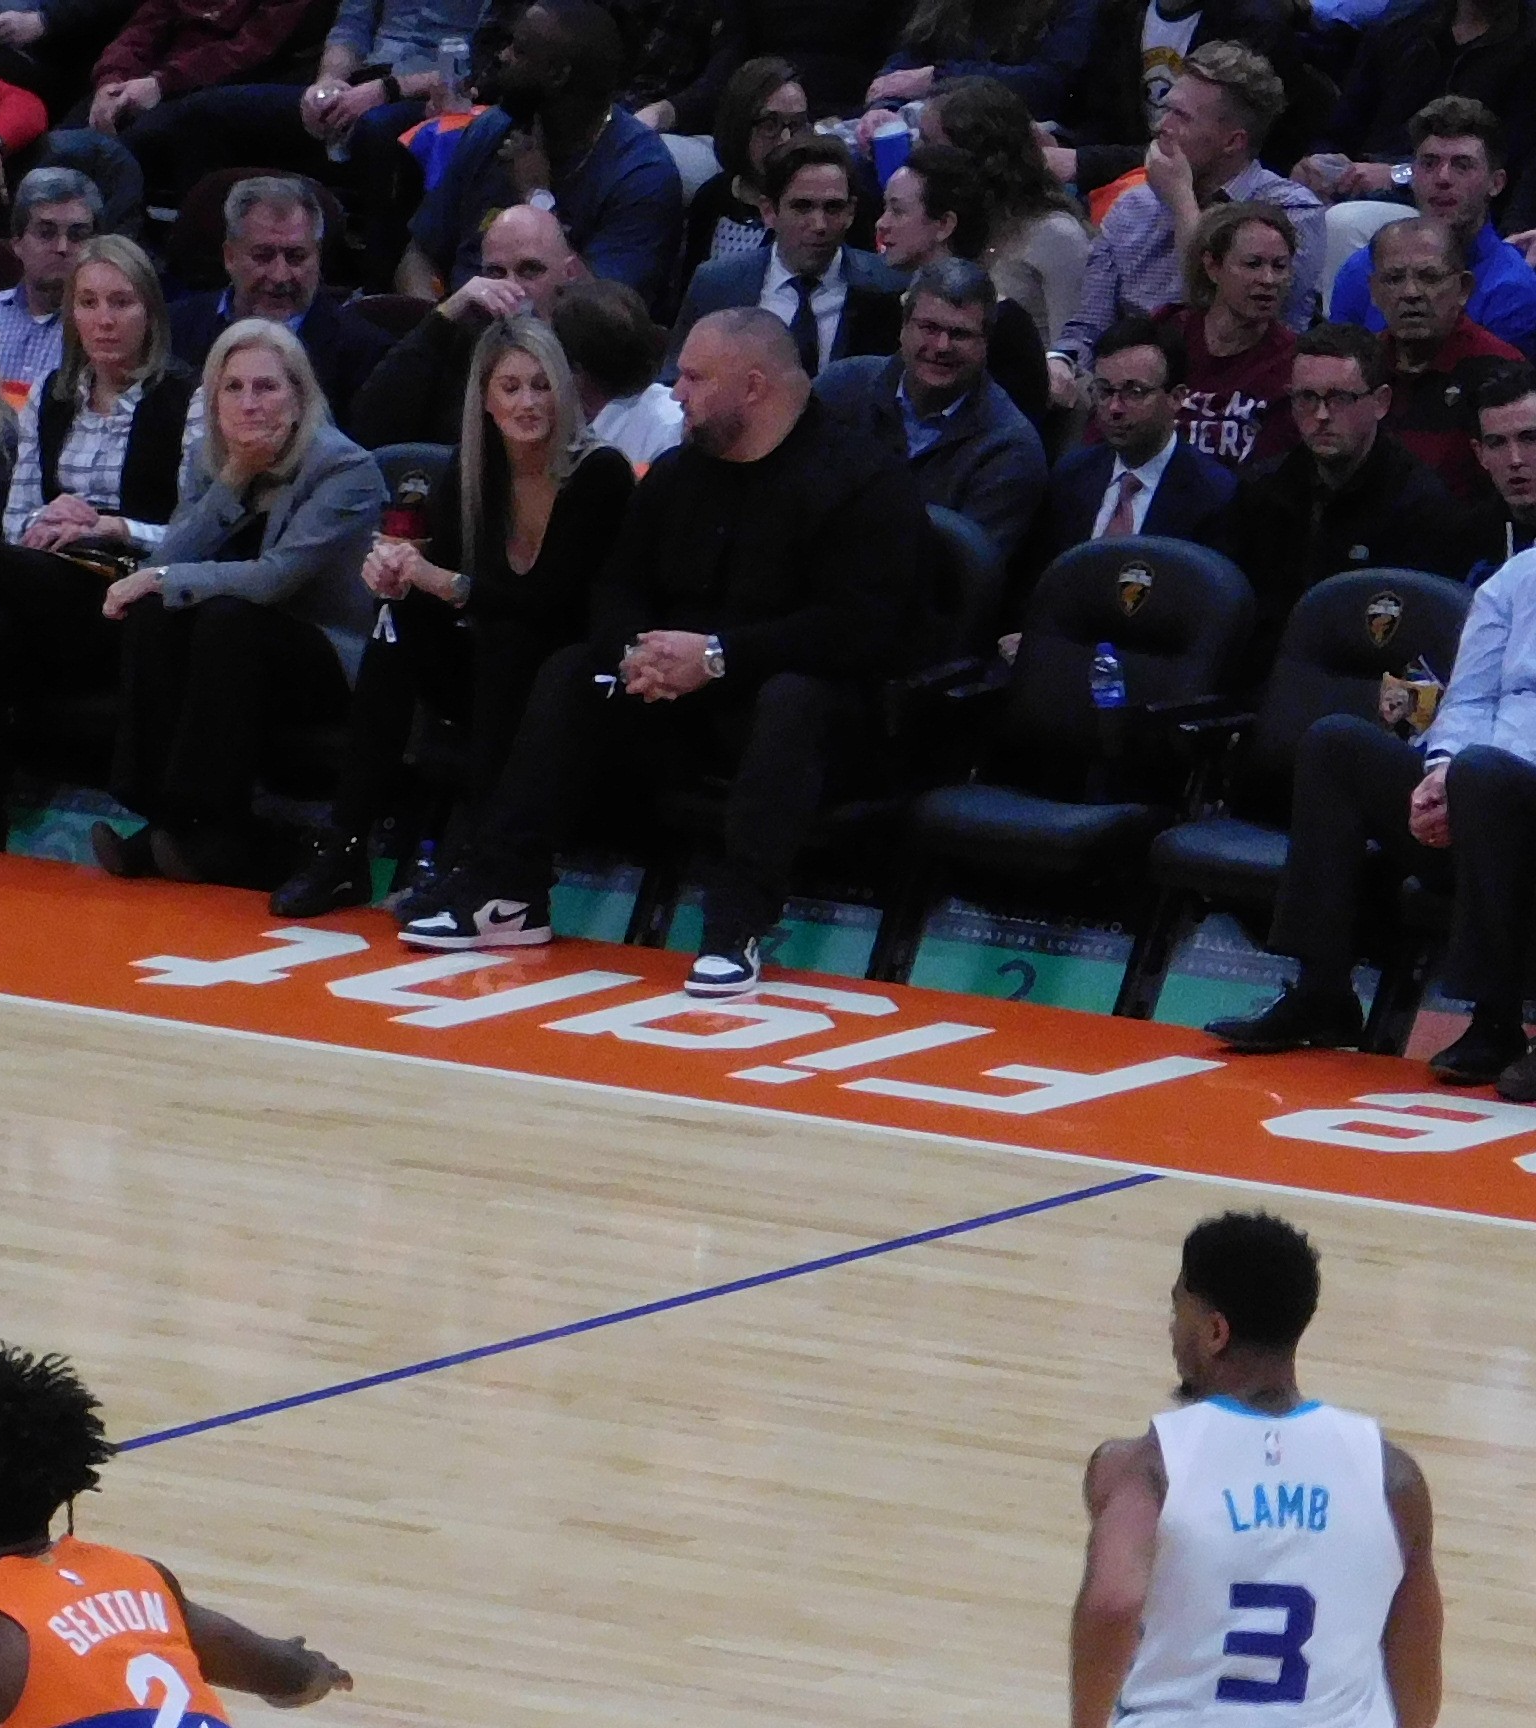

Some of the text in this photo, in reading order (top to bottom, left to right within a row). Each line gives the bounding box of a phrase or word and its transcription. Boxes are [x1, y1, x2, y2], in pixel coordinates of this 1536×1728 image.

[128, 925, 1228, 1114] Fight
[1221, 1480, 1330, 1532] LAMB
[47, 1589, 169, 1656] SEXTON
[1215, 1580, 1317, 1703] 3
